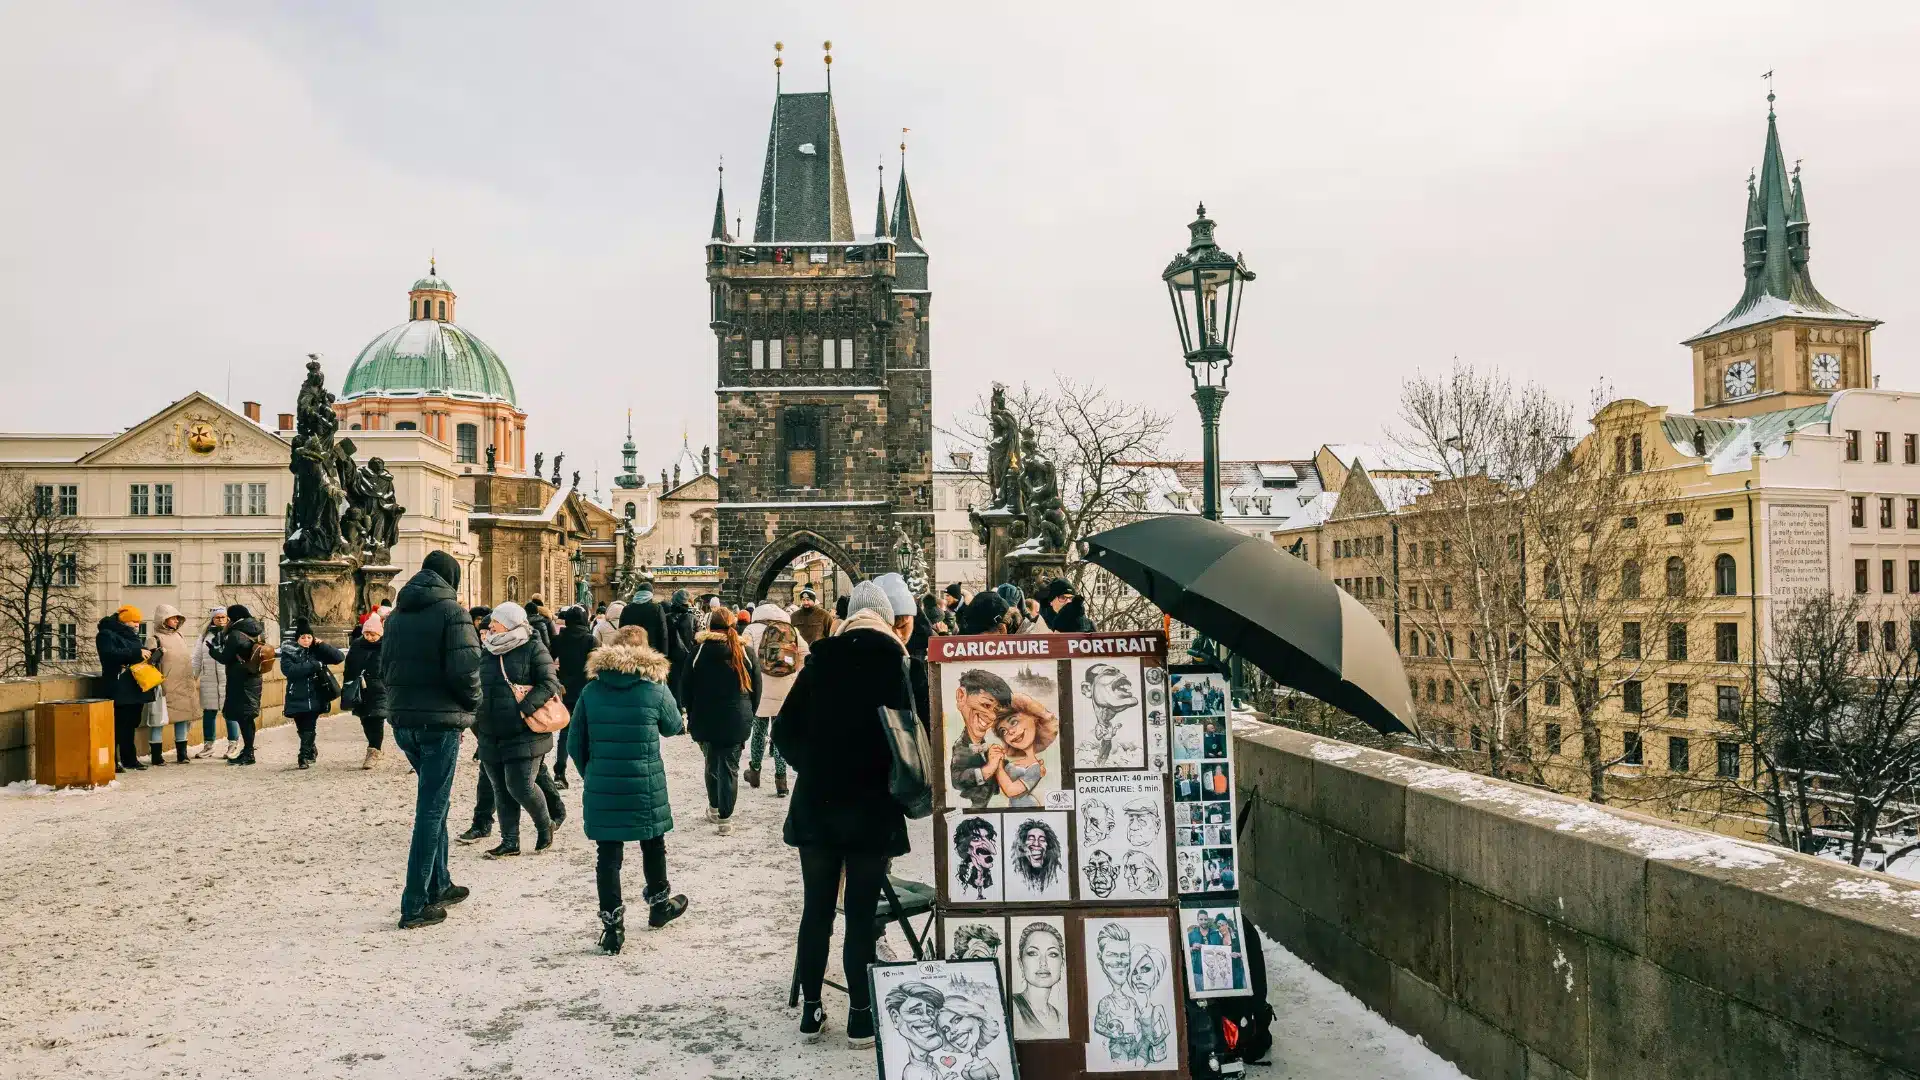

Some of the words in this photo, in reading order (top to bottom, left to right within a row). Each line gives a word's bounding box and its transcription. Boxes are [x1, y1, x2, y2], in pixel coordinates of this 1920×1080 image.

[942, 640, 1050, 658] CARICATURE
[1067, 637, 1158, 654] PORTRAIT
[1078, 774, 1130, 783] PORTRAIT:
[1143, 773, 1161, 781] min.
[1079, 785, 1135, 794] CARICATURE:
[1145, 784, 1161, 792] min.
